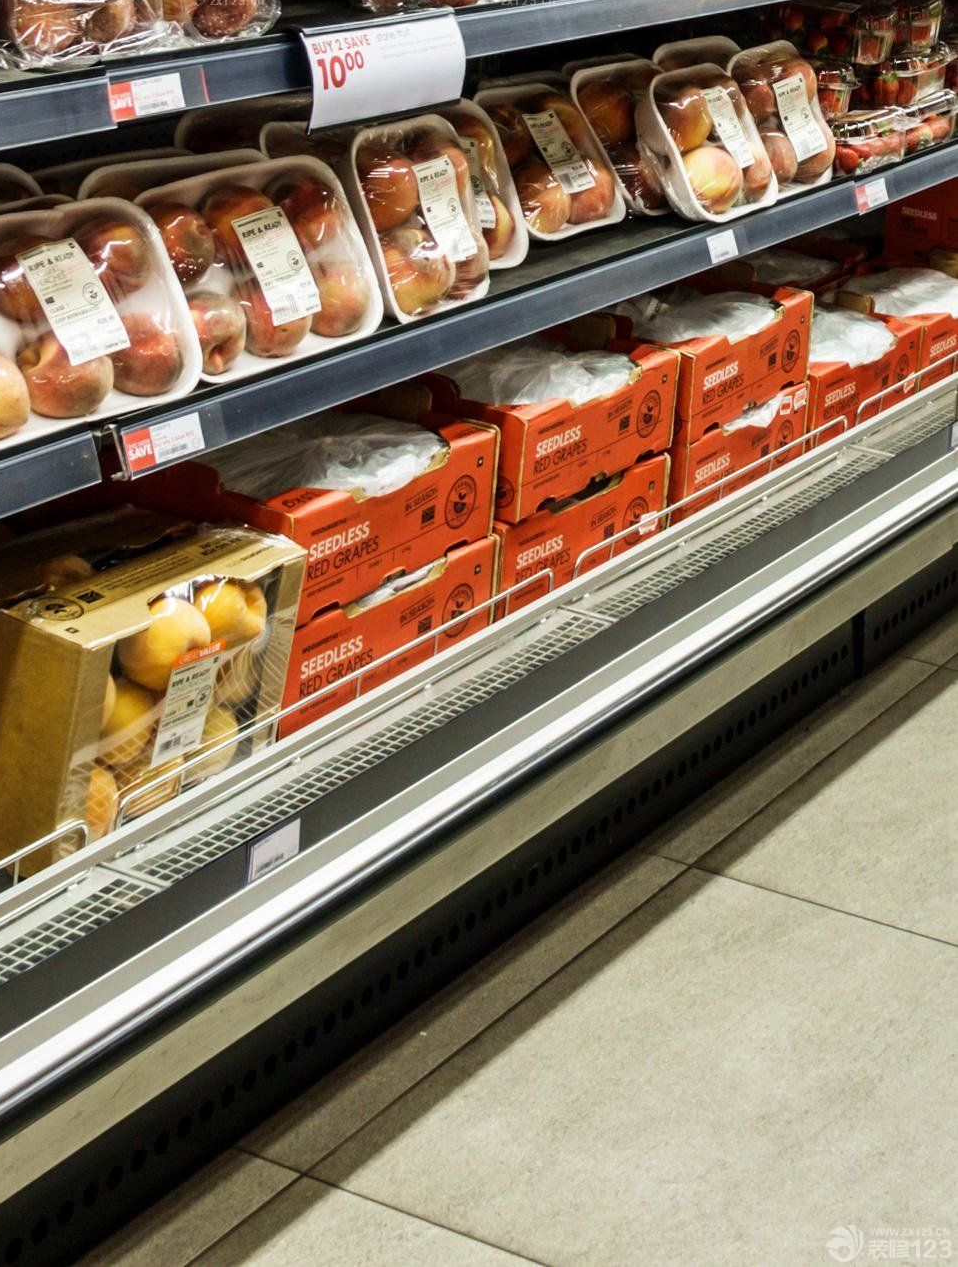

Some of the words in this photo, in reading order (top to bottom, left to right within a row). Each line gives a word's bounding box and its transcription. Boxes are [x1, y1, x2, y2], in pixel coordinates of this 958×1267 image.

[311, 40, 334, 55] BUY
[334, 38, 344, 52] 2
[345, 34, 371, 51] SAVE
[28, 260, 46, 272] RIPE
[54, 252, 75, 262] READY
[703, 361, 739, 390] SEEDLESS
[128, 444, 153, 461] SAVE
[533, 456, 551, 476] RED
[553, 439, 589, 470] GRAPES
[536, 425, 582, 459] SEEDLESS
[694, 453, 731, 484] SEEDLESS
[307, 559, 330, 582] RED
[333, 536, 380, 570] GRAPES
[308, 521, 371, 562] SEEDLESS
[516, 534, 564, 570] SEEDLESS
[299, 673, 323, 697] RED
[326, 649, 374, 683] GRAPES
[300, 635, 364, 679] SEEDLESS
